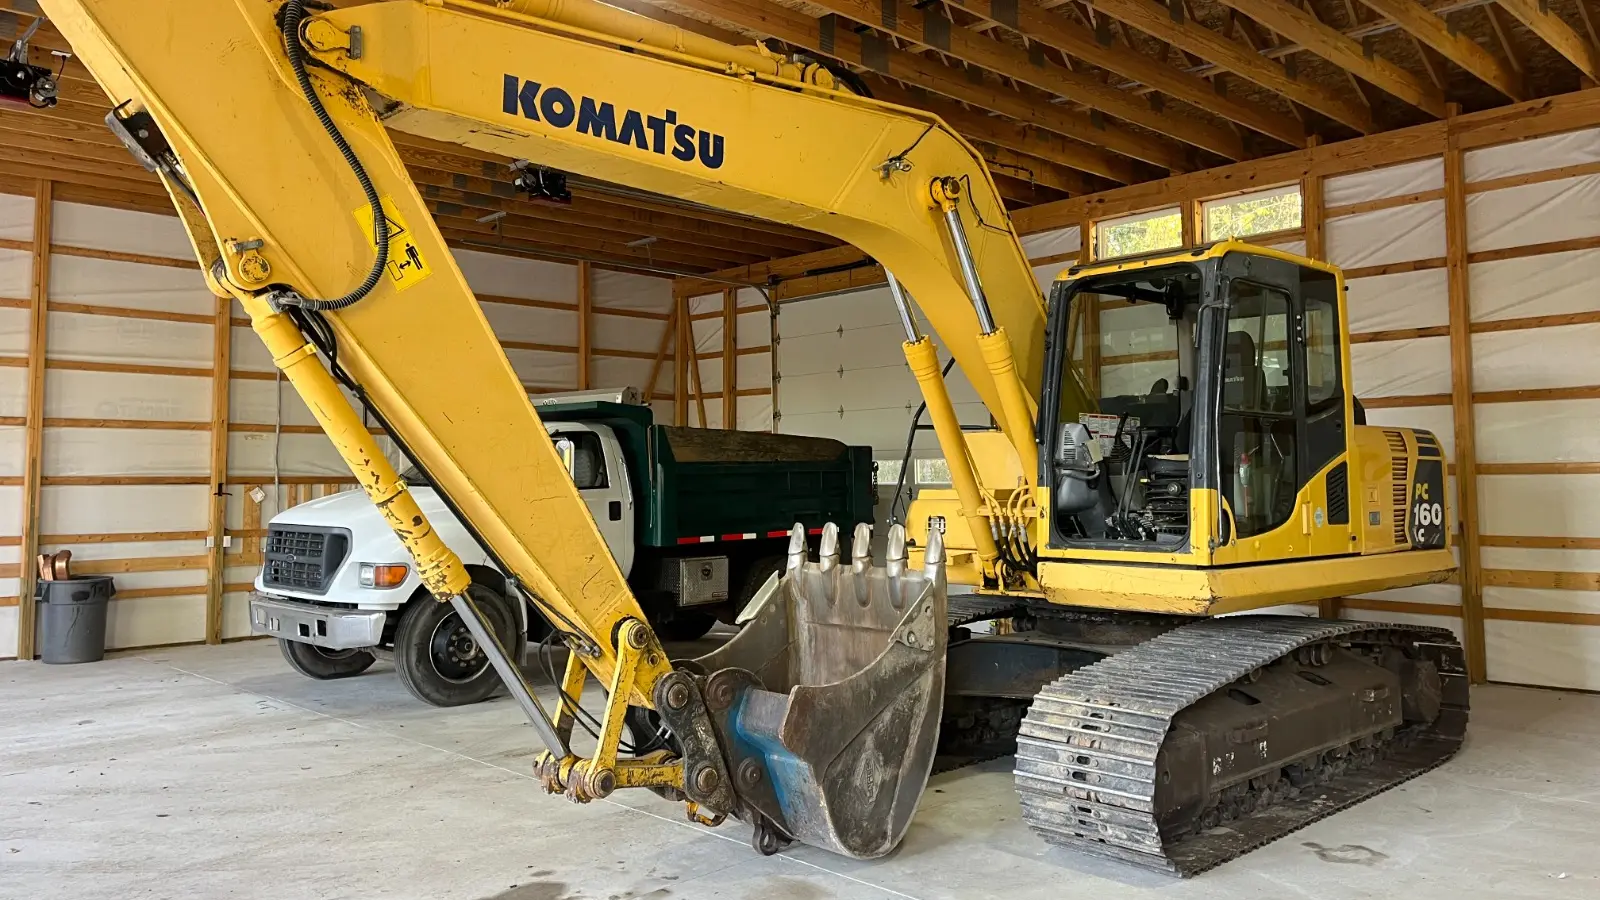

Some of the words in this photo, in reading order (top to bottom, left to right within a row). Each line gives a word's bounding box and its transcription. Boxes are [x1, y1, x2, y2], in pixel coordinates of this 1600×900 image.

[502, 73, 725, 169] KOMATSU
[1415, 483, 1429, 500] PC
[1413, 503, 1442, 526] 160
